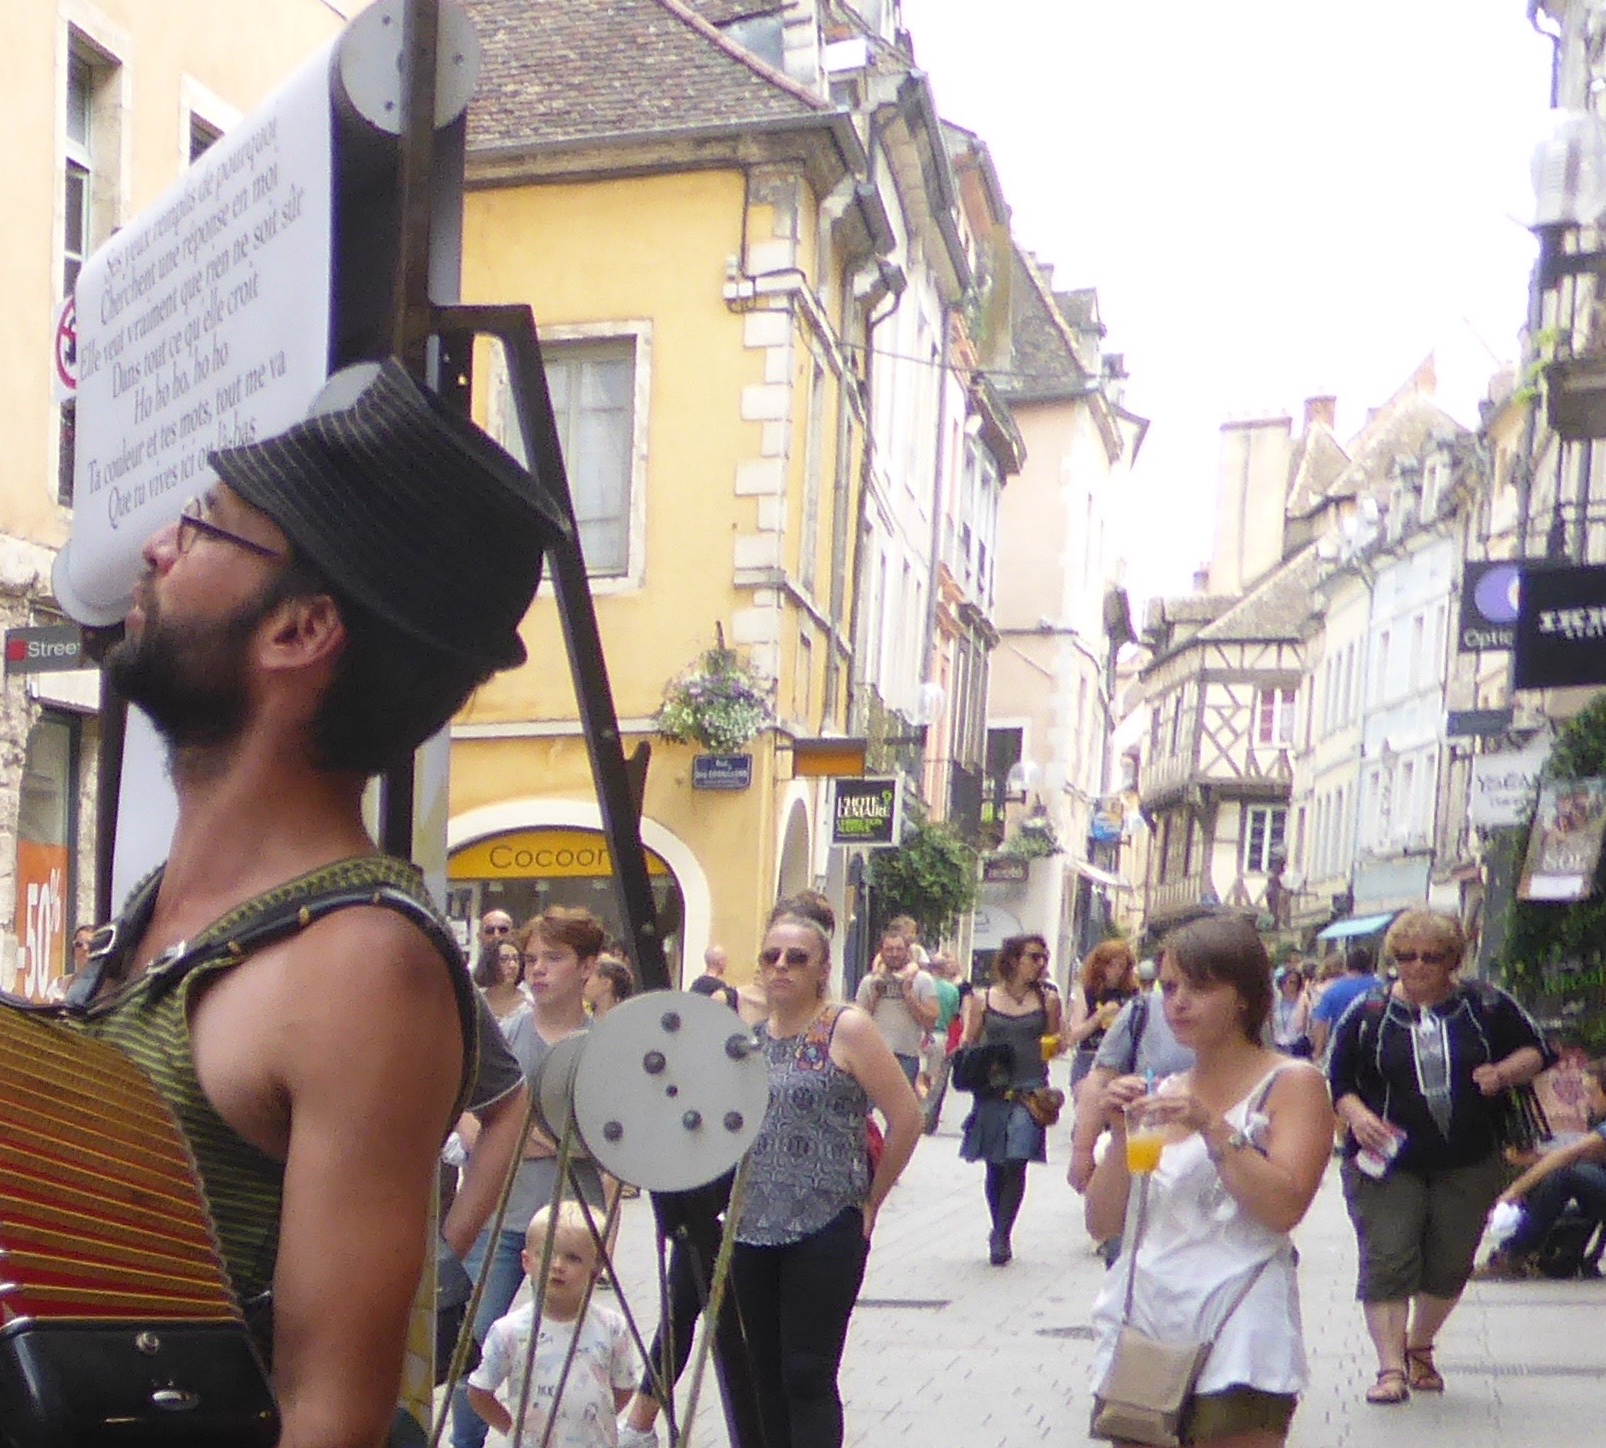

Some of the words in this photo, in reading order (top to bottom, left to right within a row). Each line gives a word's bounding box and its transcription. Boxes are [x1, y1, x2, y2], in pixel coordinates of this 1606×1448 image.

[81, 339, 100, 381] Elle
[104, 330, 124, 361] veut
[127, 288, 177, 343] vraiment
[181, 271, 203, 315] que
[206, 245, 229, 284] rien
[233, 233, 249, 265] ne
[253, 200, 277, 250] soit
[101, 263, 156, 326] Cherchent
[159, 246, 179, 279] une
[232, 188, 248, 219] en
[253, 162, 278, 203] moi
[113, 362, 141, 399] Dans
[144, 340, 166, 376] tout
[169, 332, 182, 358] ce
[227, 261, 259, 315] croit
[134, 387, 152, 425] Ho
[156, 374, 169, 411] ho
[194, 346, 209, 384] ho
[213, 332, 229, 372] ho
[89, 459, 101, 494] Ta
[104, 437, 144, 484] couleur
[147, 430, 157, 458] et
[160, 423, 177, 450] tes
[216, 375, 241, 415] tout
[246, 364, 266, 397] me
[269, 350, 286, 379] va
[108, 486, 131, 530] Que
[134, 484, 145, 508] tu
[181, 440, 194, 481] ici
